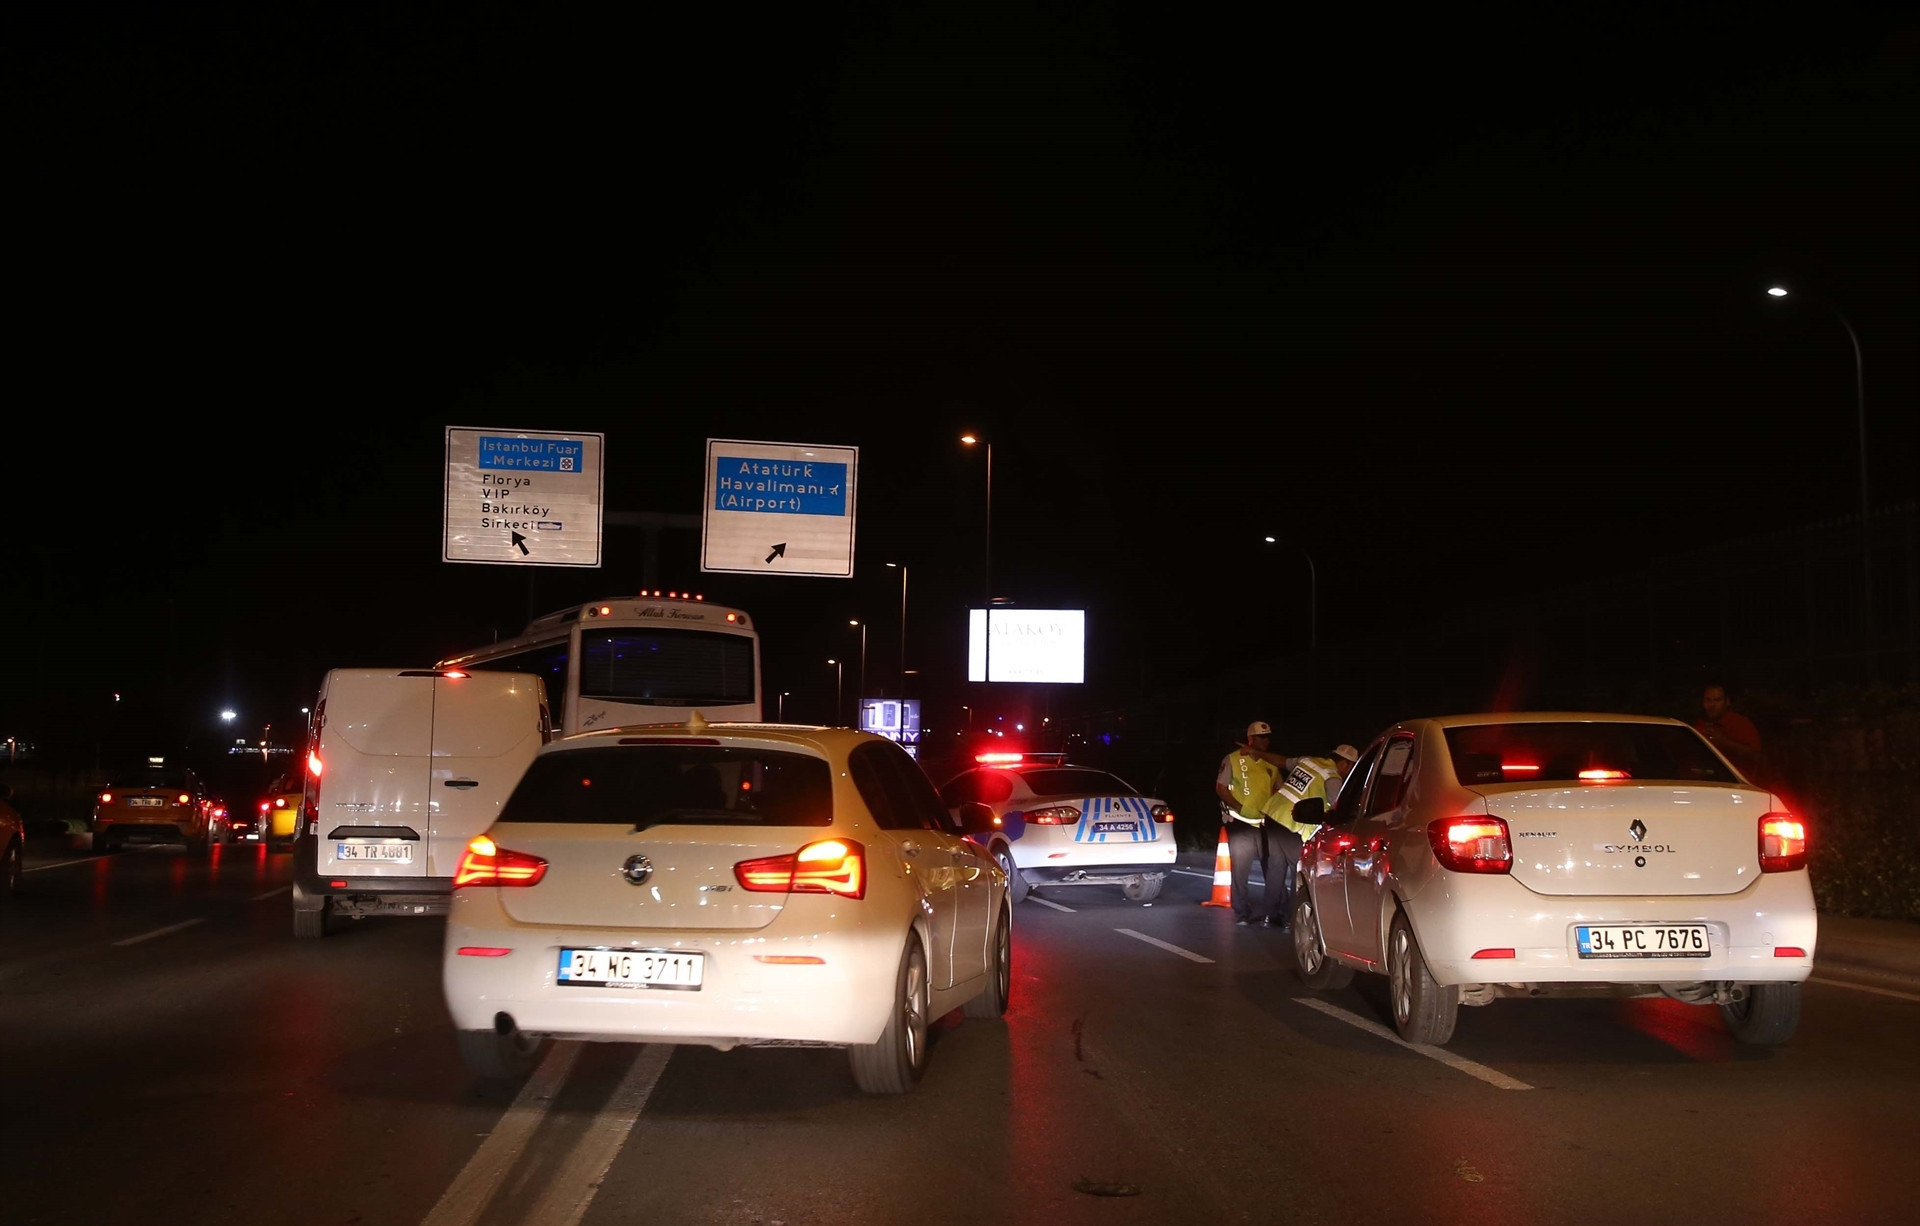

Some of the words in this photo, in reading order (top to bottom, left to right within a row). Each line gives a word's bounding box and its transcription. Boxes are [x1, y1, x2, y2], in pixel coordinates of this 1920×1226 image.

[483, 438, 543, 453] İstanbul
[547, 443, 579, 455] Fuar
[493, 455, 555, 468] Merkezi
[739, 462, 812, 478] Atatürk
[482, 474, 531, 488] Florya
[720, 477, 824, 495] Havalimanı
[482, 489, 510, 499] VIP
[720, 493, 801, 512] (Airport)
[481, 503, 550, 518] Bakırköy
[481, 518, 534, 530] Sirkeci
[344, 846, 358, 858] 34
[364, 846, 377, 858] TR
[1604, 844, 1676, 853] SYMBOL
[1591, 930, 1615, 950] 34
[1622, 930, 1647, 950] PC
[1655, 929, 1703, 950] 7676
[574, 954, 597, 978] 34
[644, 957, 693, 981] 3711
